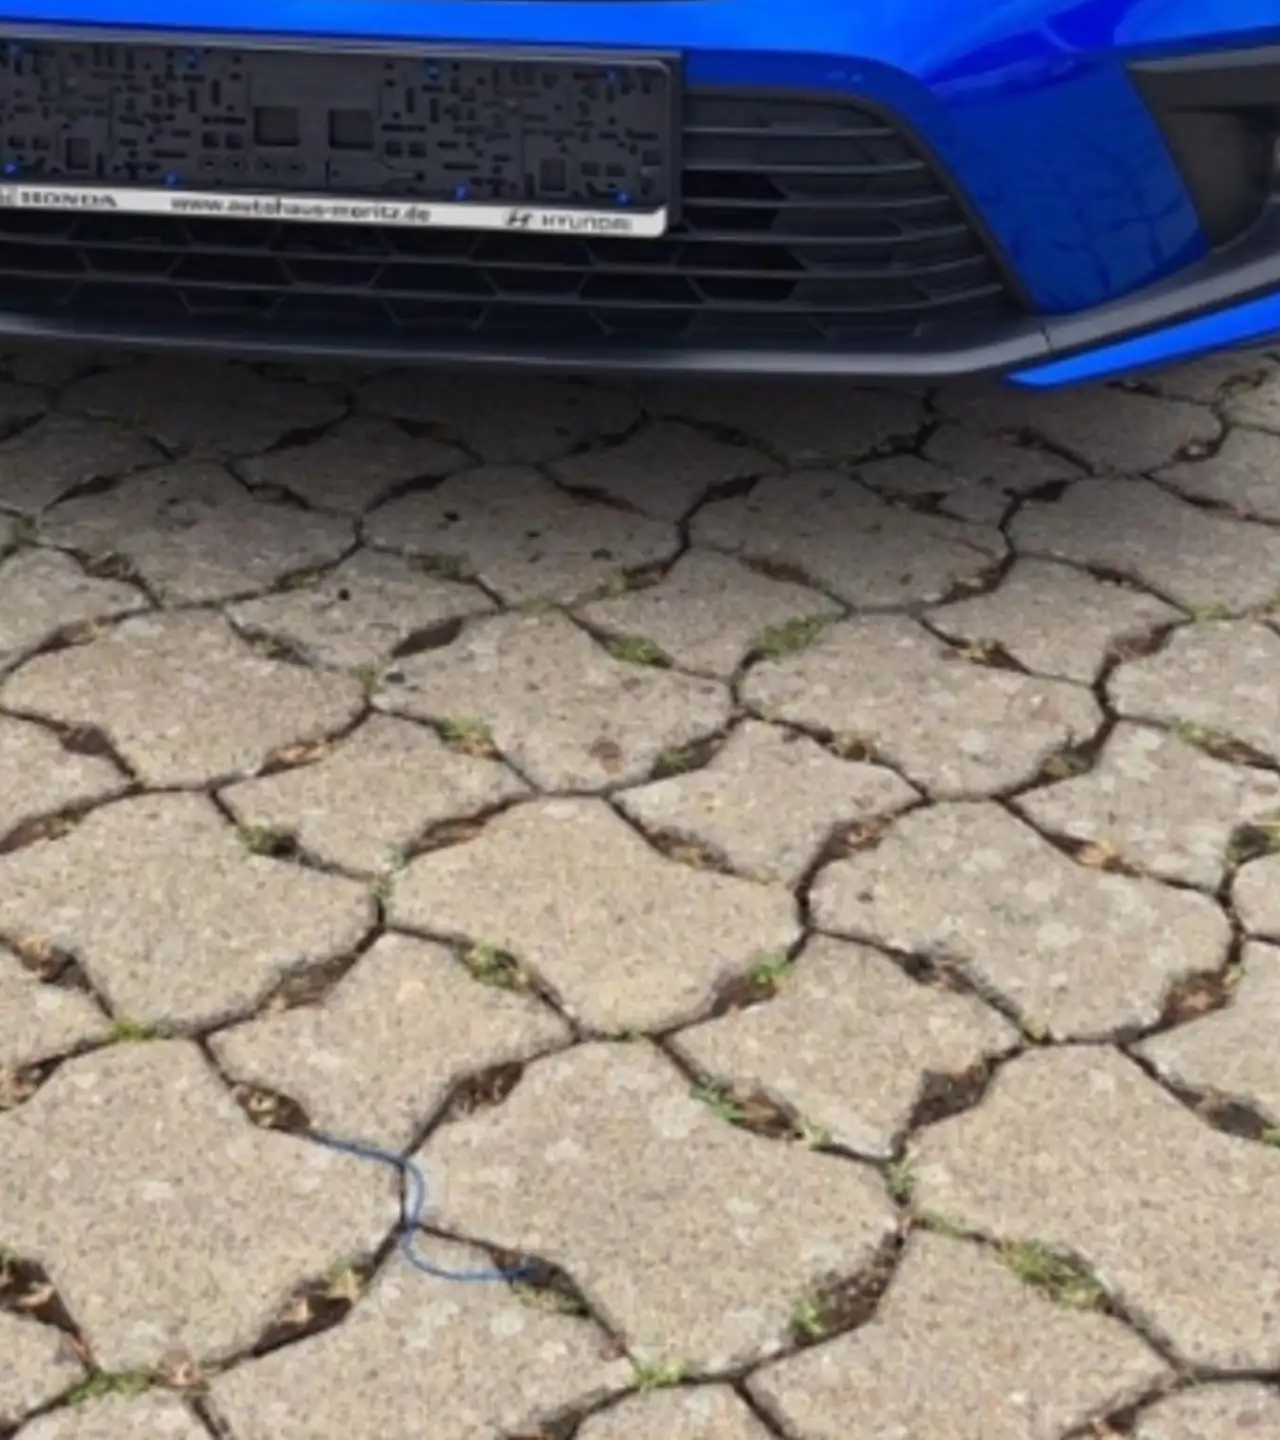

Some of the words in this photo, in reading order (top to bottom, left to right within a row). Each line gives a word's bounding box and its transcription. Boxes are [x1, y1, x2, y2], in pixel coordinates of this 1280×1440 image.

[21, 190, 118, 209] HONDA
[170, 196, 431, 224] www.autohaus-moritz.de
[540, 213, 632, 231] HYUNDAI
